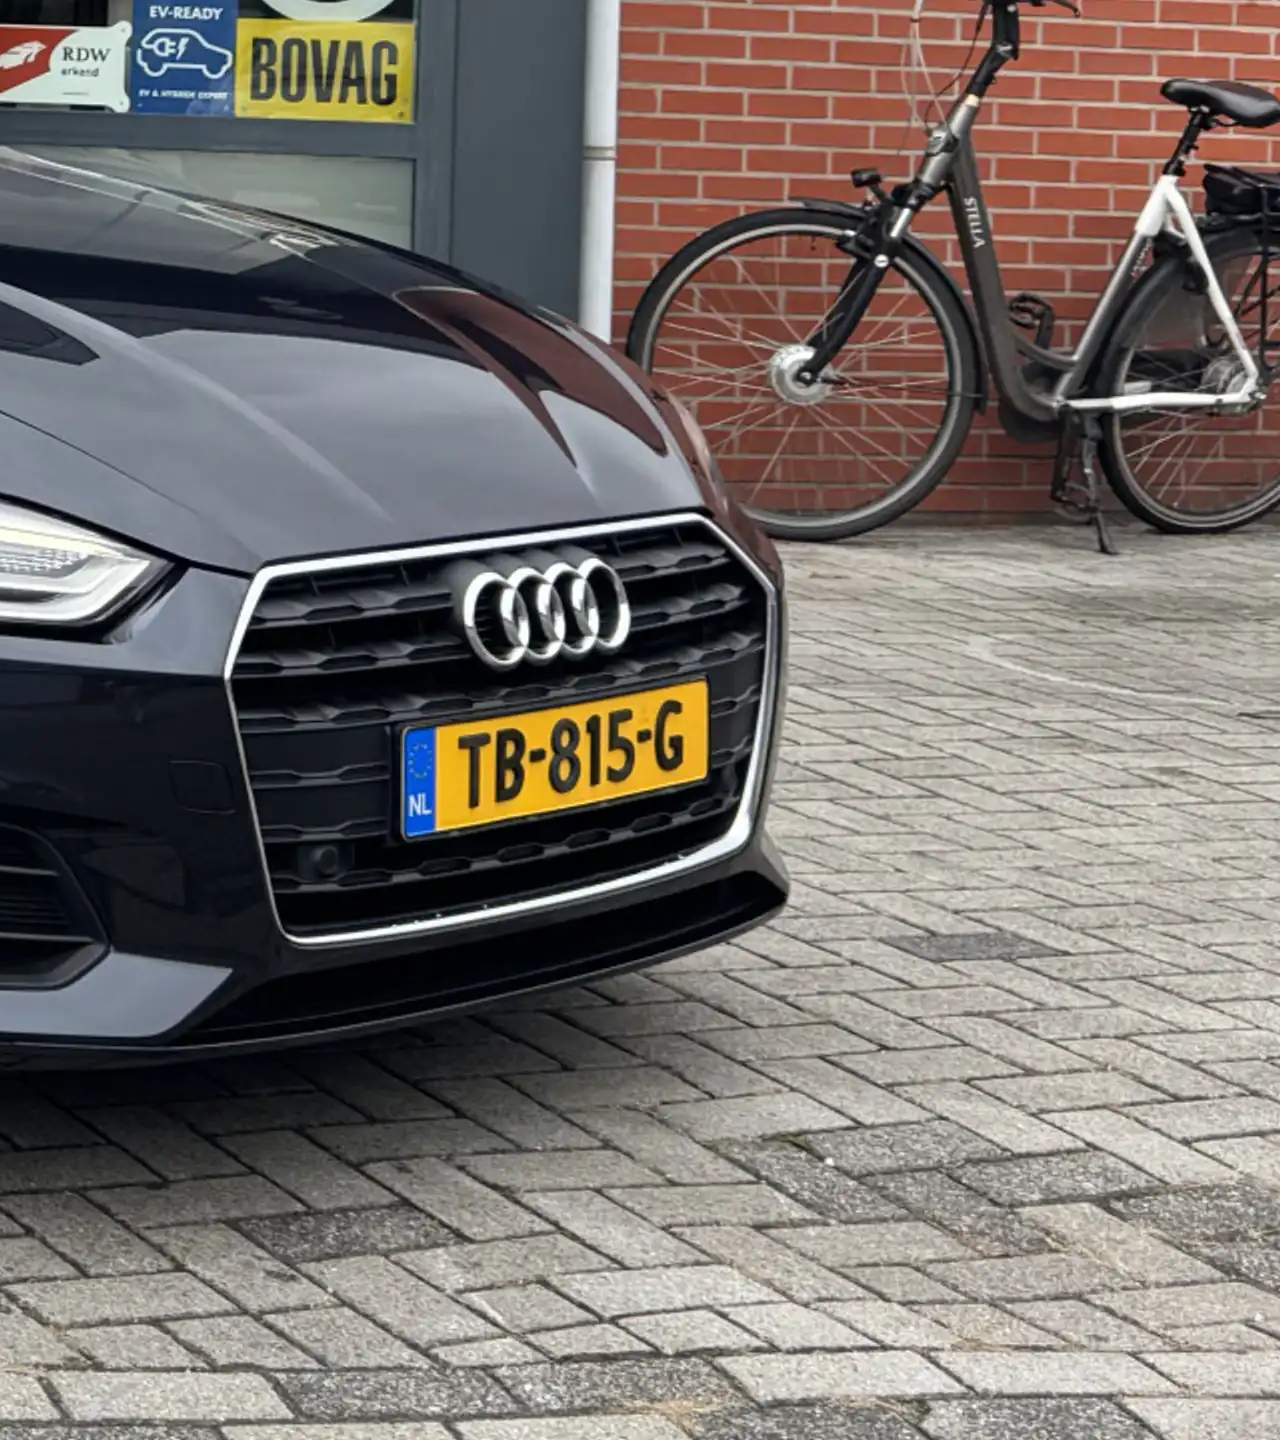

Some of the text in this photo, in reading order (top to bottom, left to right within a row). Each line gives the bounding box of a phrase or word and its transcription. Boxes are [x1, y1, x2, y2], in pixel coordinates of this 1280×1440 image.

[149, 5, 224, 20] EV-READY
[62, 47, 111, 62] RDW
[61, 67, 100, 78] erkend
[249, 36, 399, 106] BOVAG
[964, 196, 987, 249] STELLA
[458, 699, 684, 809] TB-815-G
[408, 793, 433, 817] NL
